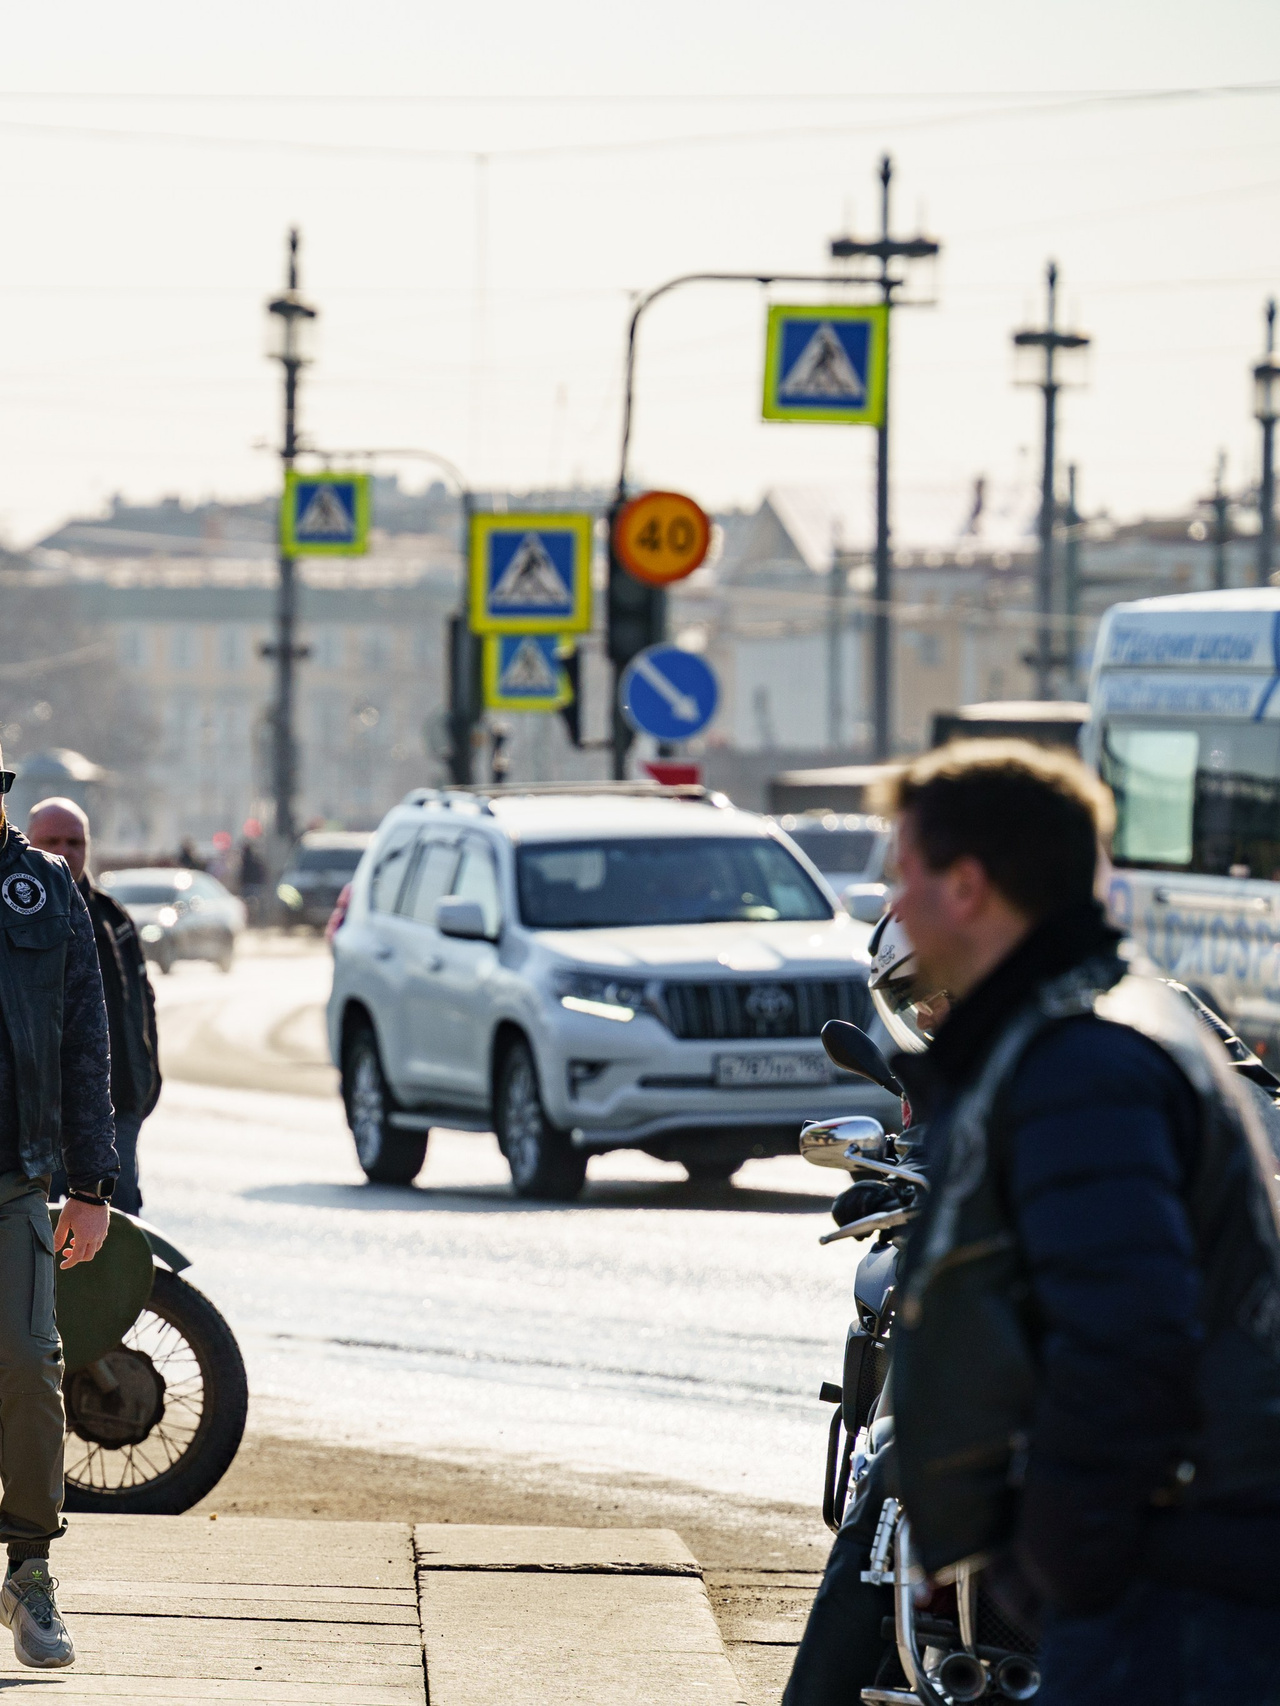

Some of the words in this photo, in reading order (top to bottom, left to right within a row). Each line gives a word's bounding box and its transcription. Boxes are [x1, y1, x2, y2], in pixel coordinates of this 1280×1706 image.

[636, 516, 696, 556] 40
[4, 873, 22, 886] SUPPORT
[23, 874, 36, 882] CLUB
[9, 902, 18, 911] THE
